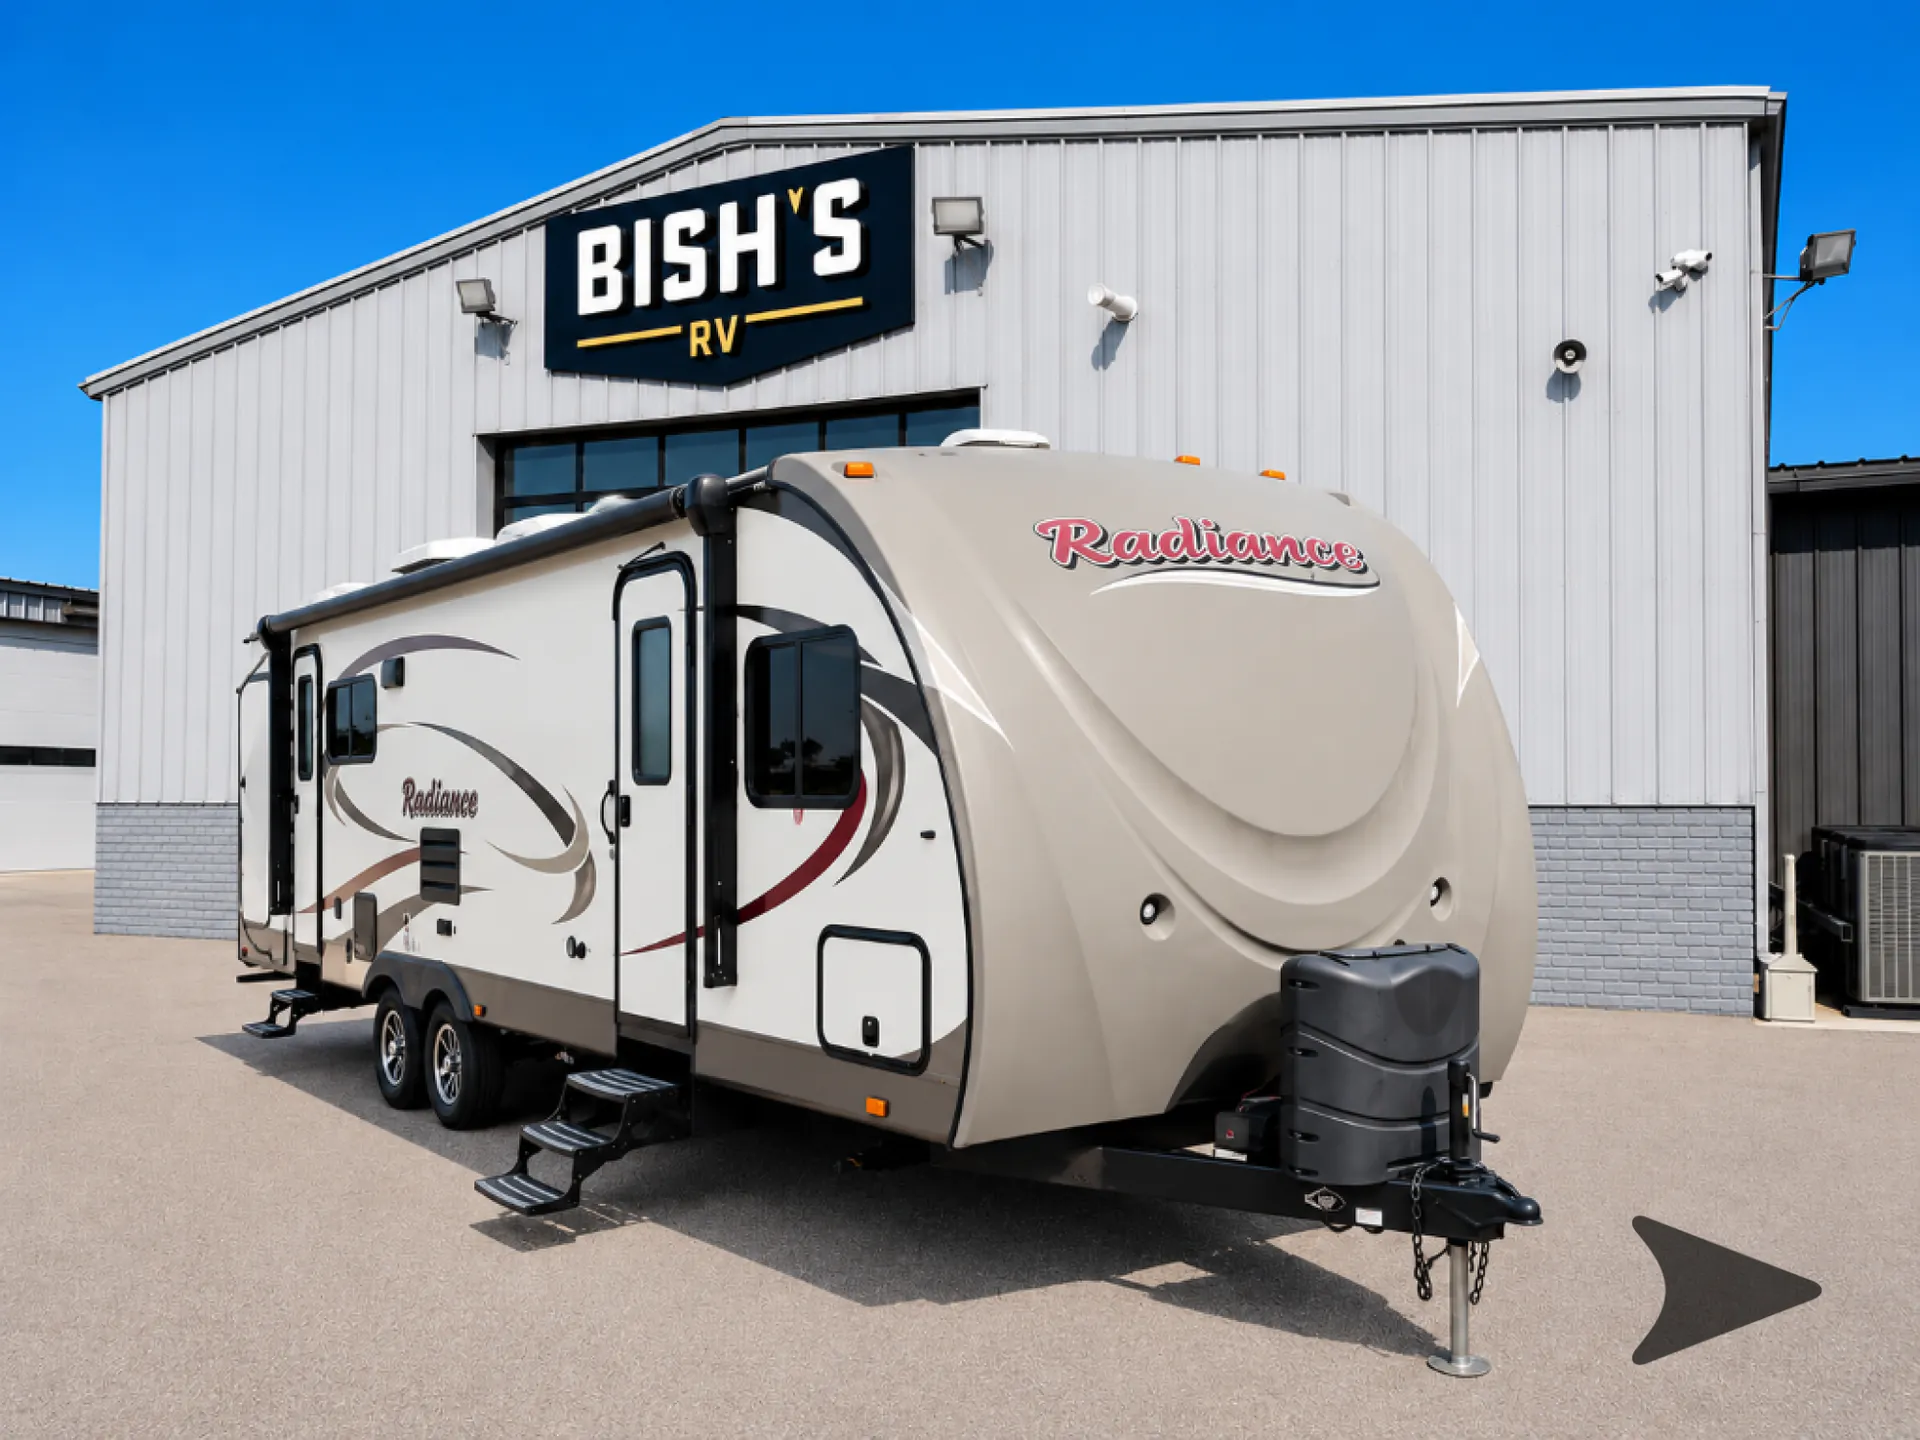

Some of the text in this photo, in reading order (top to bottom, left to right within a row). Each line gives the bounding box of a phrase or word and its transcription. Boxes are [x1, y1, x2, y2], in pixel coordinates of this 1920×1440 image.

[577, 177, 862, 316] BISH'S
[689, 314, 738, 358] RV
[1033, 516, 1367, 574] Radiance
[402, 776, 478, 819] Radiance
